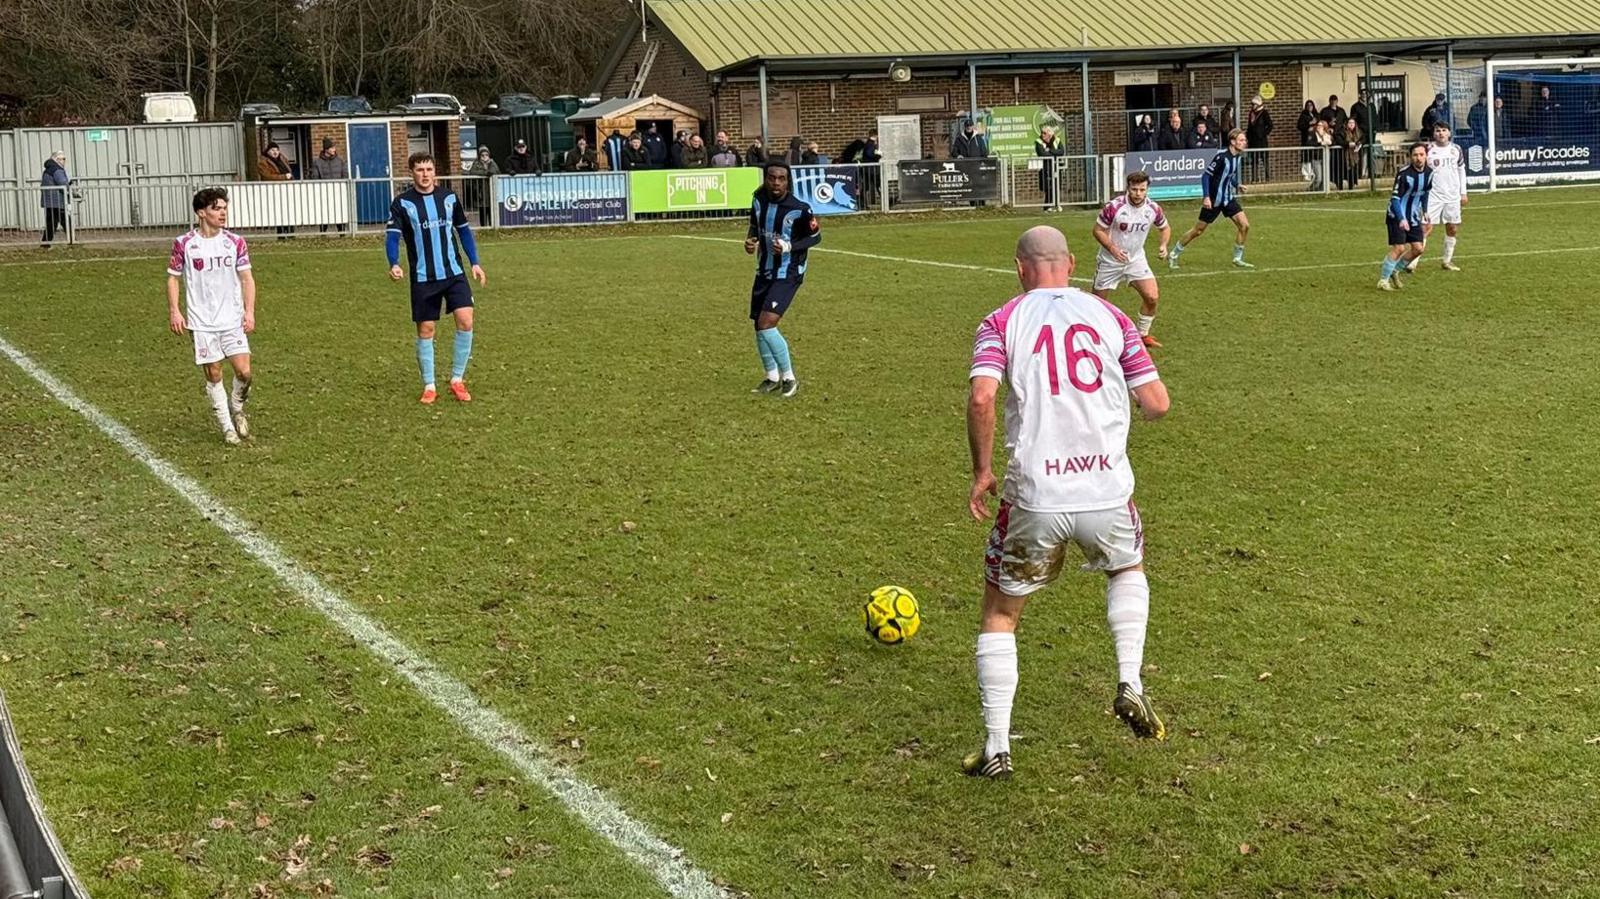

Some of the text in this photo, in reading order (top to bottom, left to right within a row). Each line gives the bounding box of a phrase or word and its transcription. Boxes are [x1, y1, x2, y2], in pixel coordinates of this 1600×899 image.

[1537, 145, 1590, 159] Facades
[1154, 155, 1205, 171] dandara
[675, 175, 719, 191] PITCHING
[932, 172, 970, 184] FULLER'S
[696, 190, 707, 204] IN
[523, 199, 577, 211] ATHLETIC
[605, 200, 622, 209] Club
[1128, 222, 1149, 232] JTC
[207, 256, 233, 272] JTC
[1031, 322, 1104, 396] 16
[1045, 454, 1113, 476] HAWK
